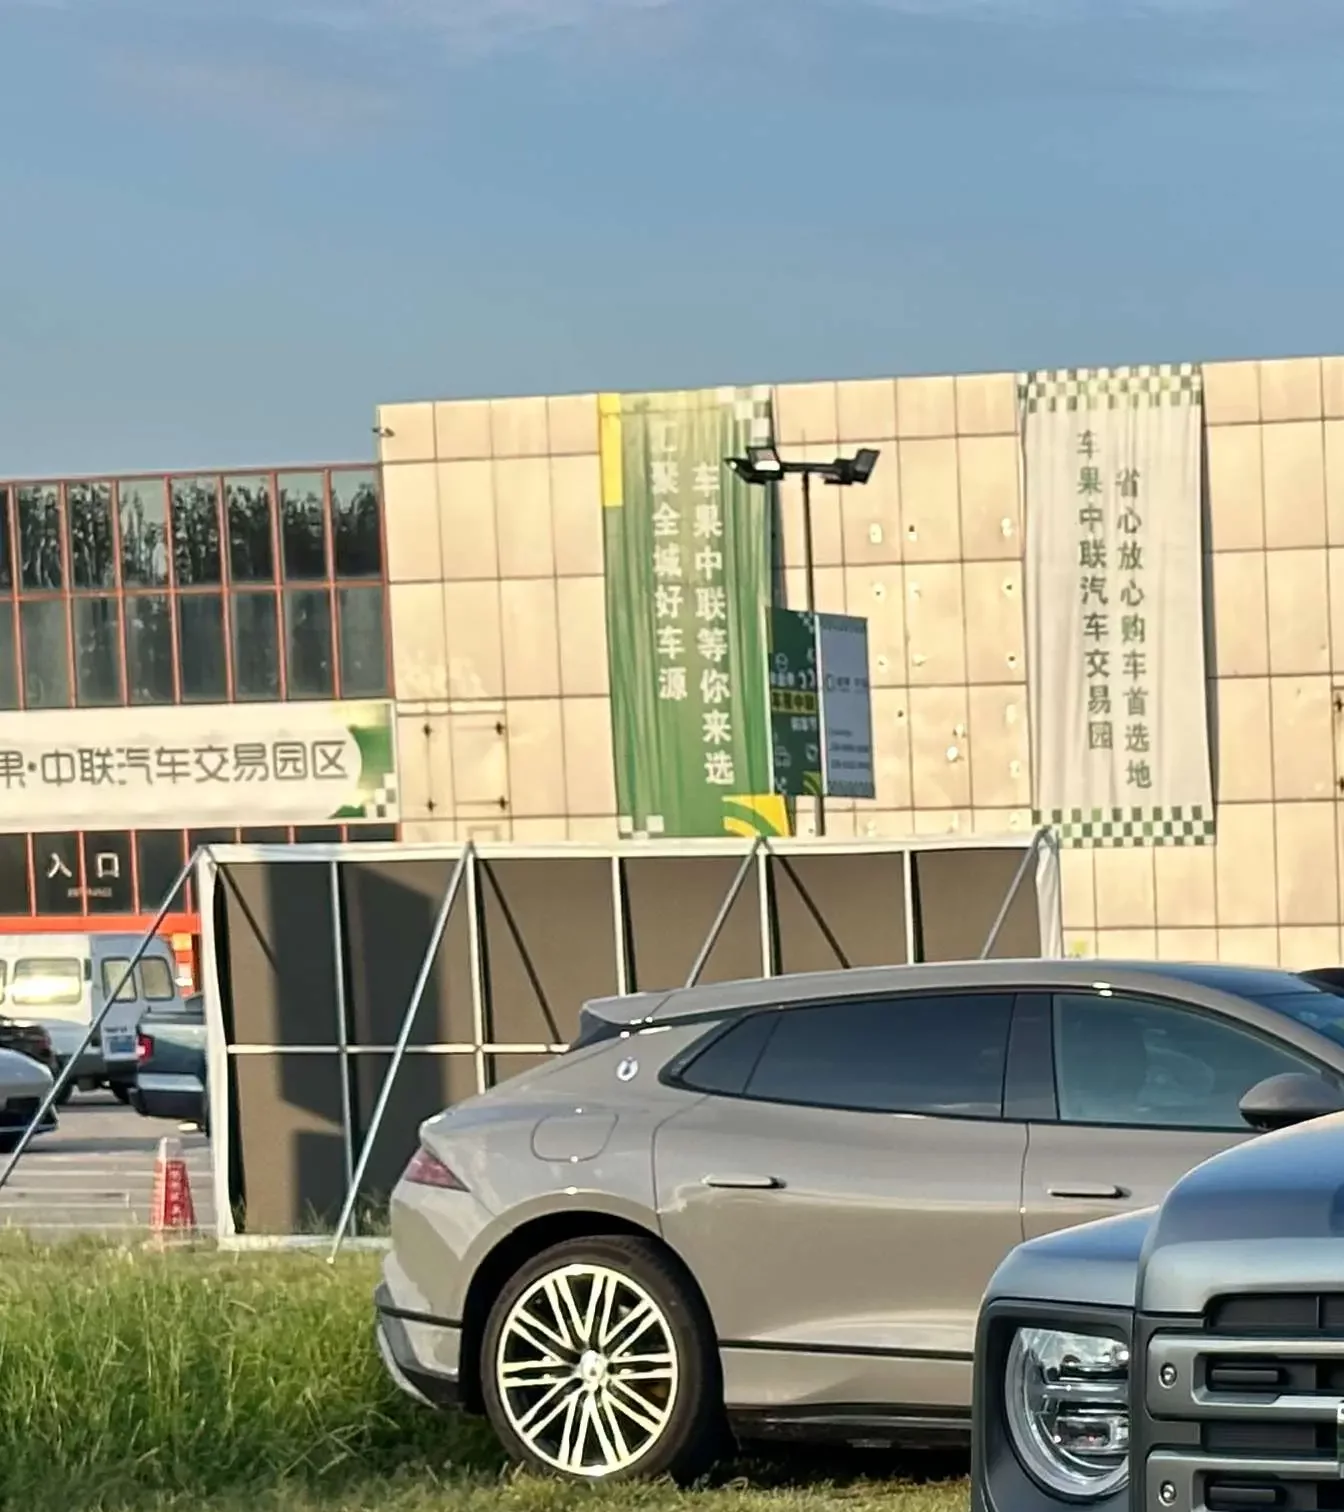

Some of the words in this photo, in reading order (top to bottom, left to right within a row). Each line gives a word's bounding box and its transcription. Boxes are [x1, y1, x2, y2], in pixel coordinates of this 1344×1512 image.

[692, 462, 734, 785] 车果中联等你来选
[1076, 430, 1113, 750] 车果中联汽车交易园
[1114, 467, 1152, 789] 省心放心购车首选地
[47, 852, 120, 878] 入口
